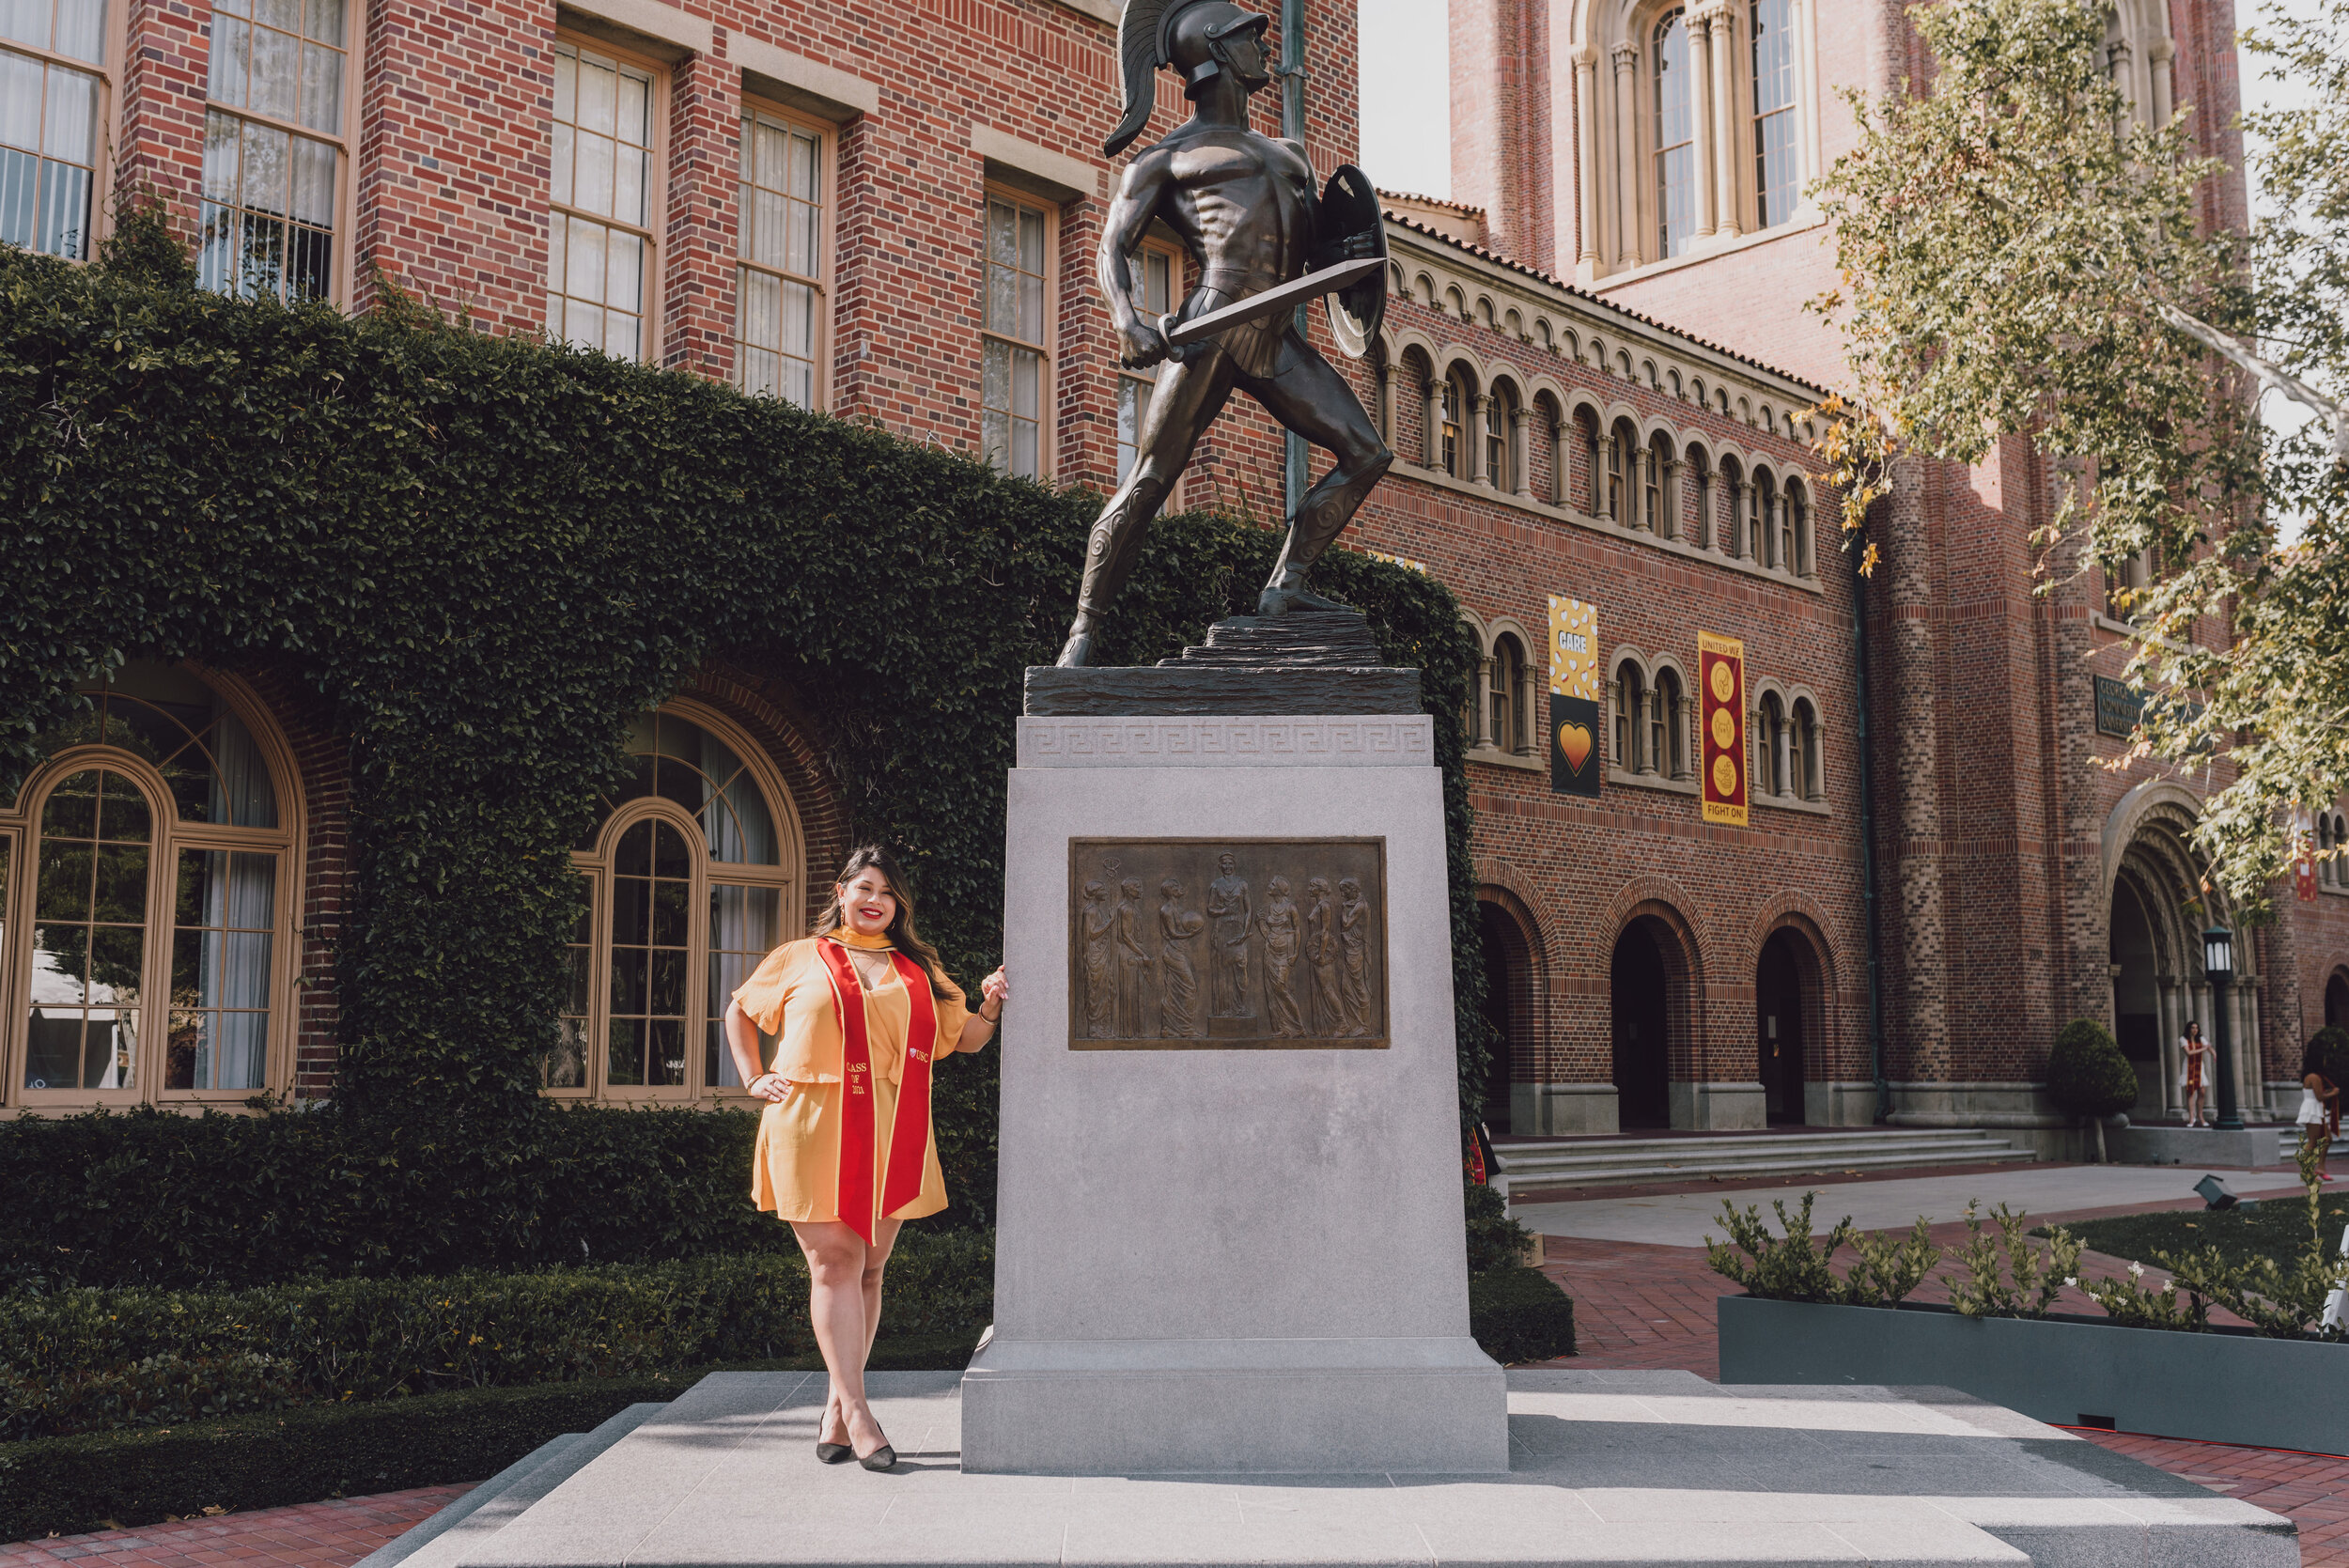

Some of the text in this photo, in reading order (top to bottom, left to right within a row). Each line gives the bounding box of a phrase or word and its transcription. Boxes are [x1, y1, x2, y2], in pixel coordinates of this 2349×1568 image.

[1558, 629, 1587, 654] CARE
[1702, 639, 1740, 657] UNITED WE
[2100, 680, 2128, 701] GEORGE
[1707, 804, 1744, 819] FIGHT ON!
[916, 1049, 929, 1063] USC
